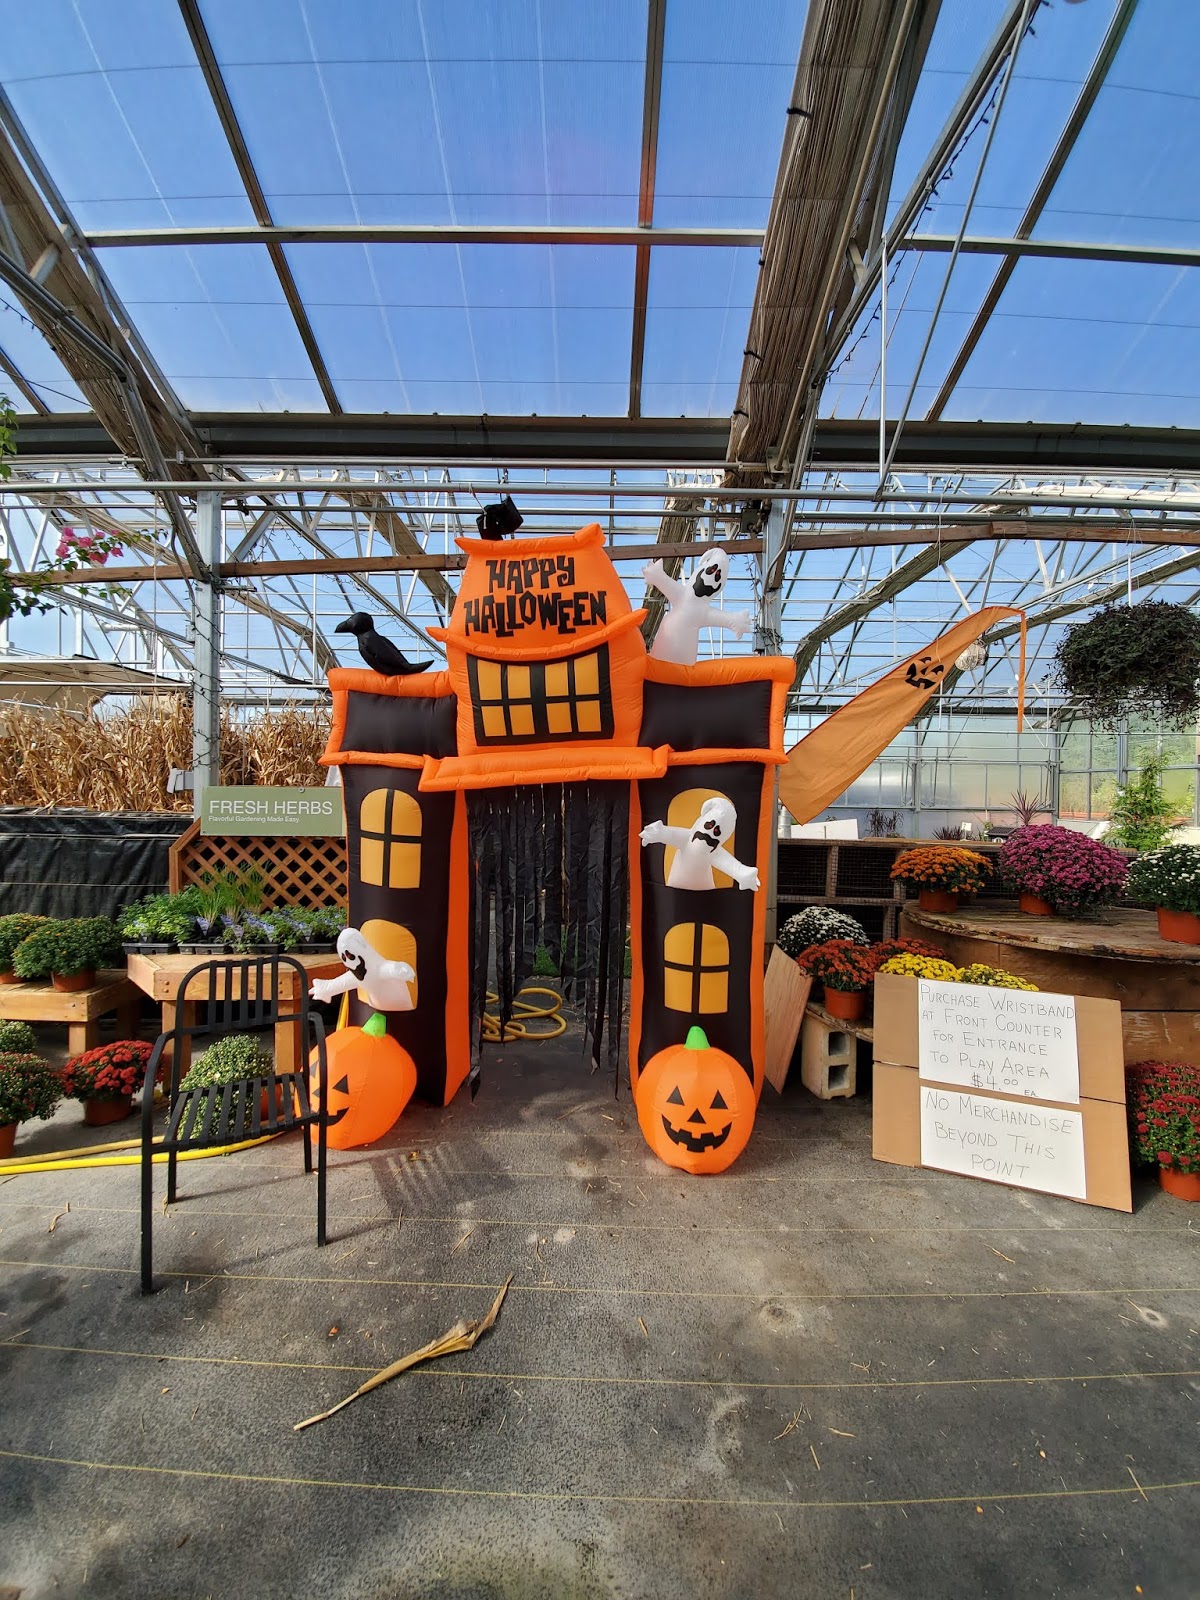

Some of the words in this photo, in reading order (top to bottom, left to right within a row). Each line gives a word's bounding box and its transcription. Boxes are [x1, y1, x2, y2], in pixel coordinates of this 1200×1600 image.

[486, 555, 575, 594] HAPPY
[464, 590, 607, 638] HALLOWEEN
[208, 815, 235, 823] Flavorful
[235, 815, 267, 824] Gardening
[209, 800, 269, 815] FRESH
[274, 800, 333, 815] HERBS
[920, 984, 980, 1008] PURCHASE
[988, 992, 1075, 1019] WRISTBAND
[922, 1010, 935, 1021] AT
[944, 1008, 987, 1029] FRONT
[995, 1014, 1062, 1040] COUNTER
[933, 1029, 954, 1043] FOR
[963, 1031, 1048, 1056] ENTRANCE
[929, 1051, 949, 1064] TO
[959, 1052, 994, 1075] PLAY
[1001, 1057, 1050, 1080] AREA
[925, 1091, 950, 1111] NO
[959, 1095, 1074, 1134] MERCHANDISE
[934, 1121, 998, 1149] BEYOND
[1006, 1133, 1056, 1160] THIS
[970, 1153, 1031, 1179] POINT
